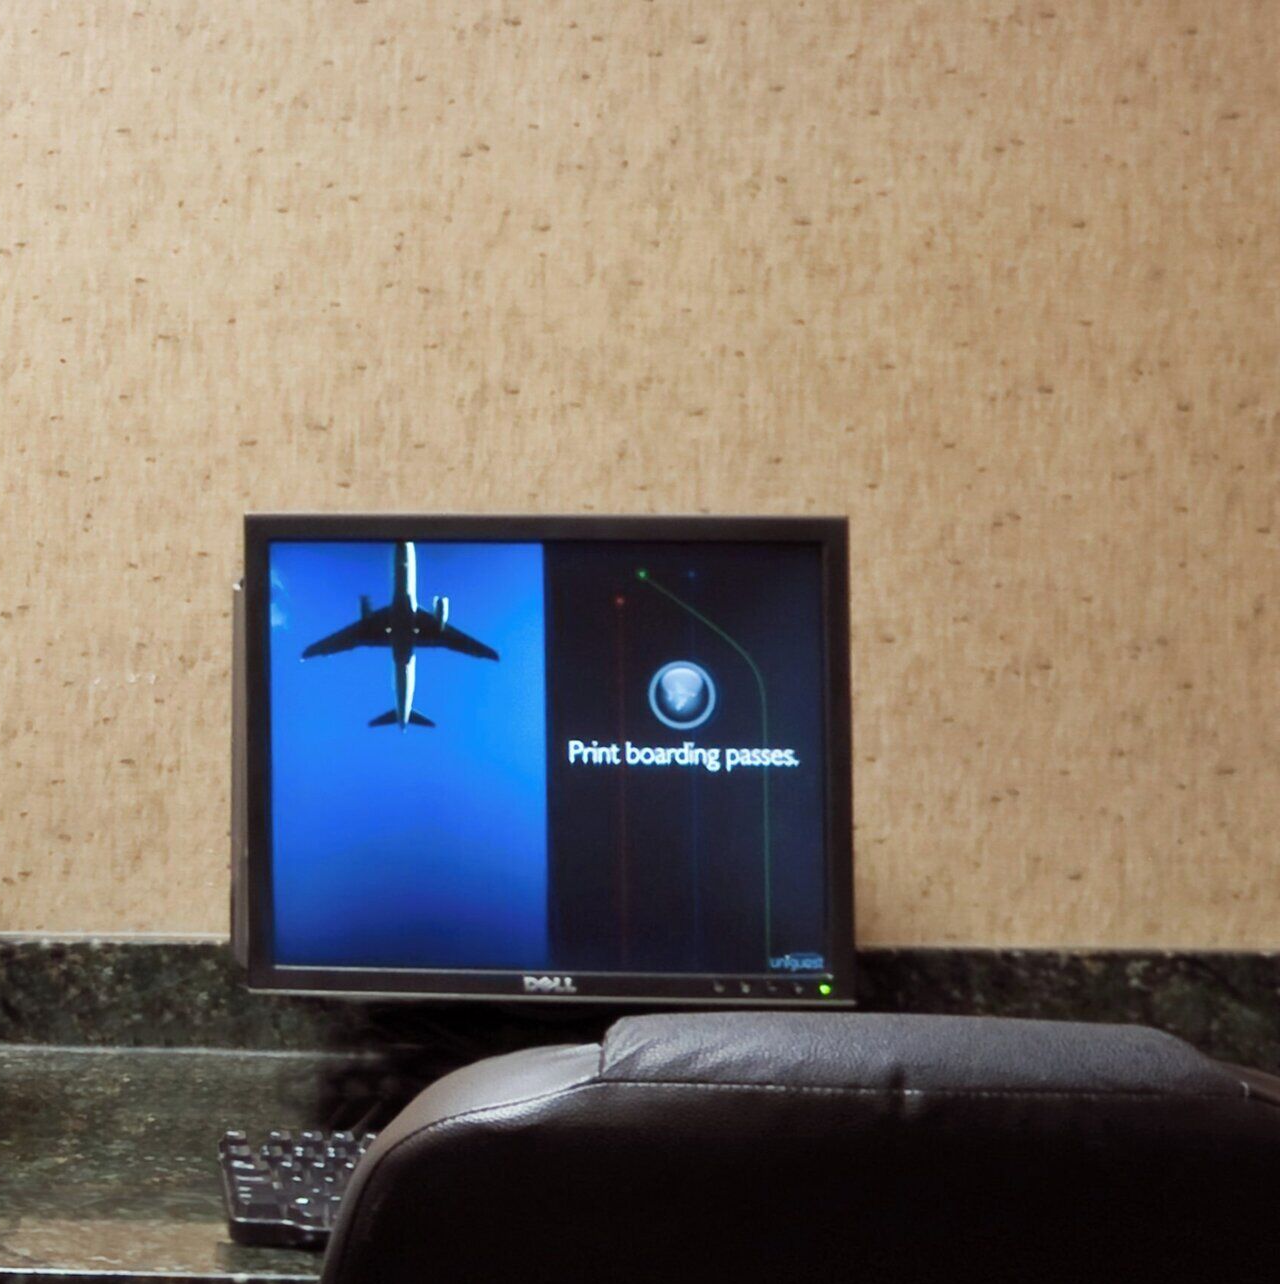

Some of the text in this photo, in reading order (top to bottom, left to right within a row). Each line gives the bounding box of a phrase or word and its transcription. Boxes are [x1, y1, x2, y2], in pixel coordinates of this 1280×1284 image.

[567, 740, 800, 772] Print boarding passes.
